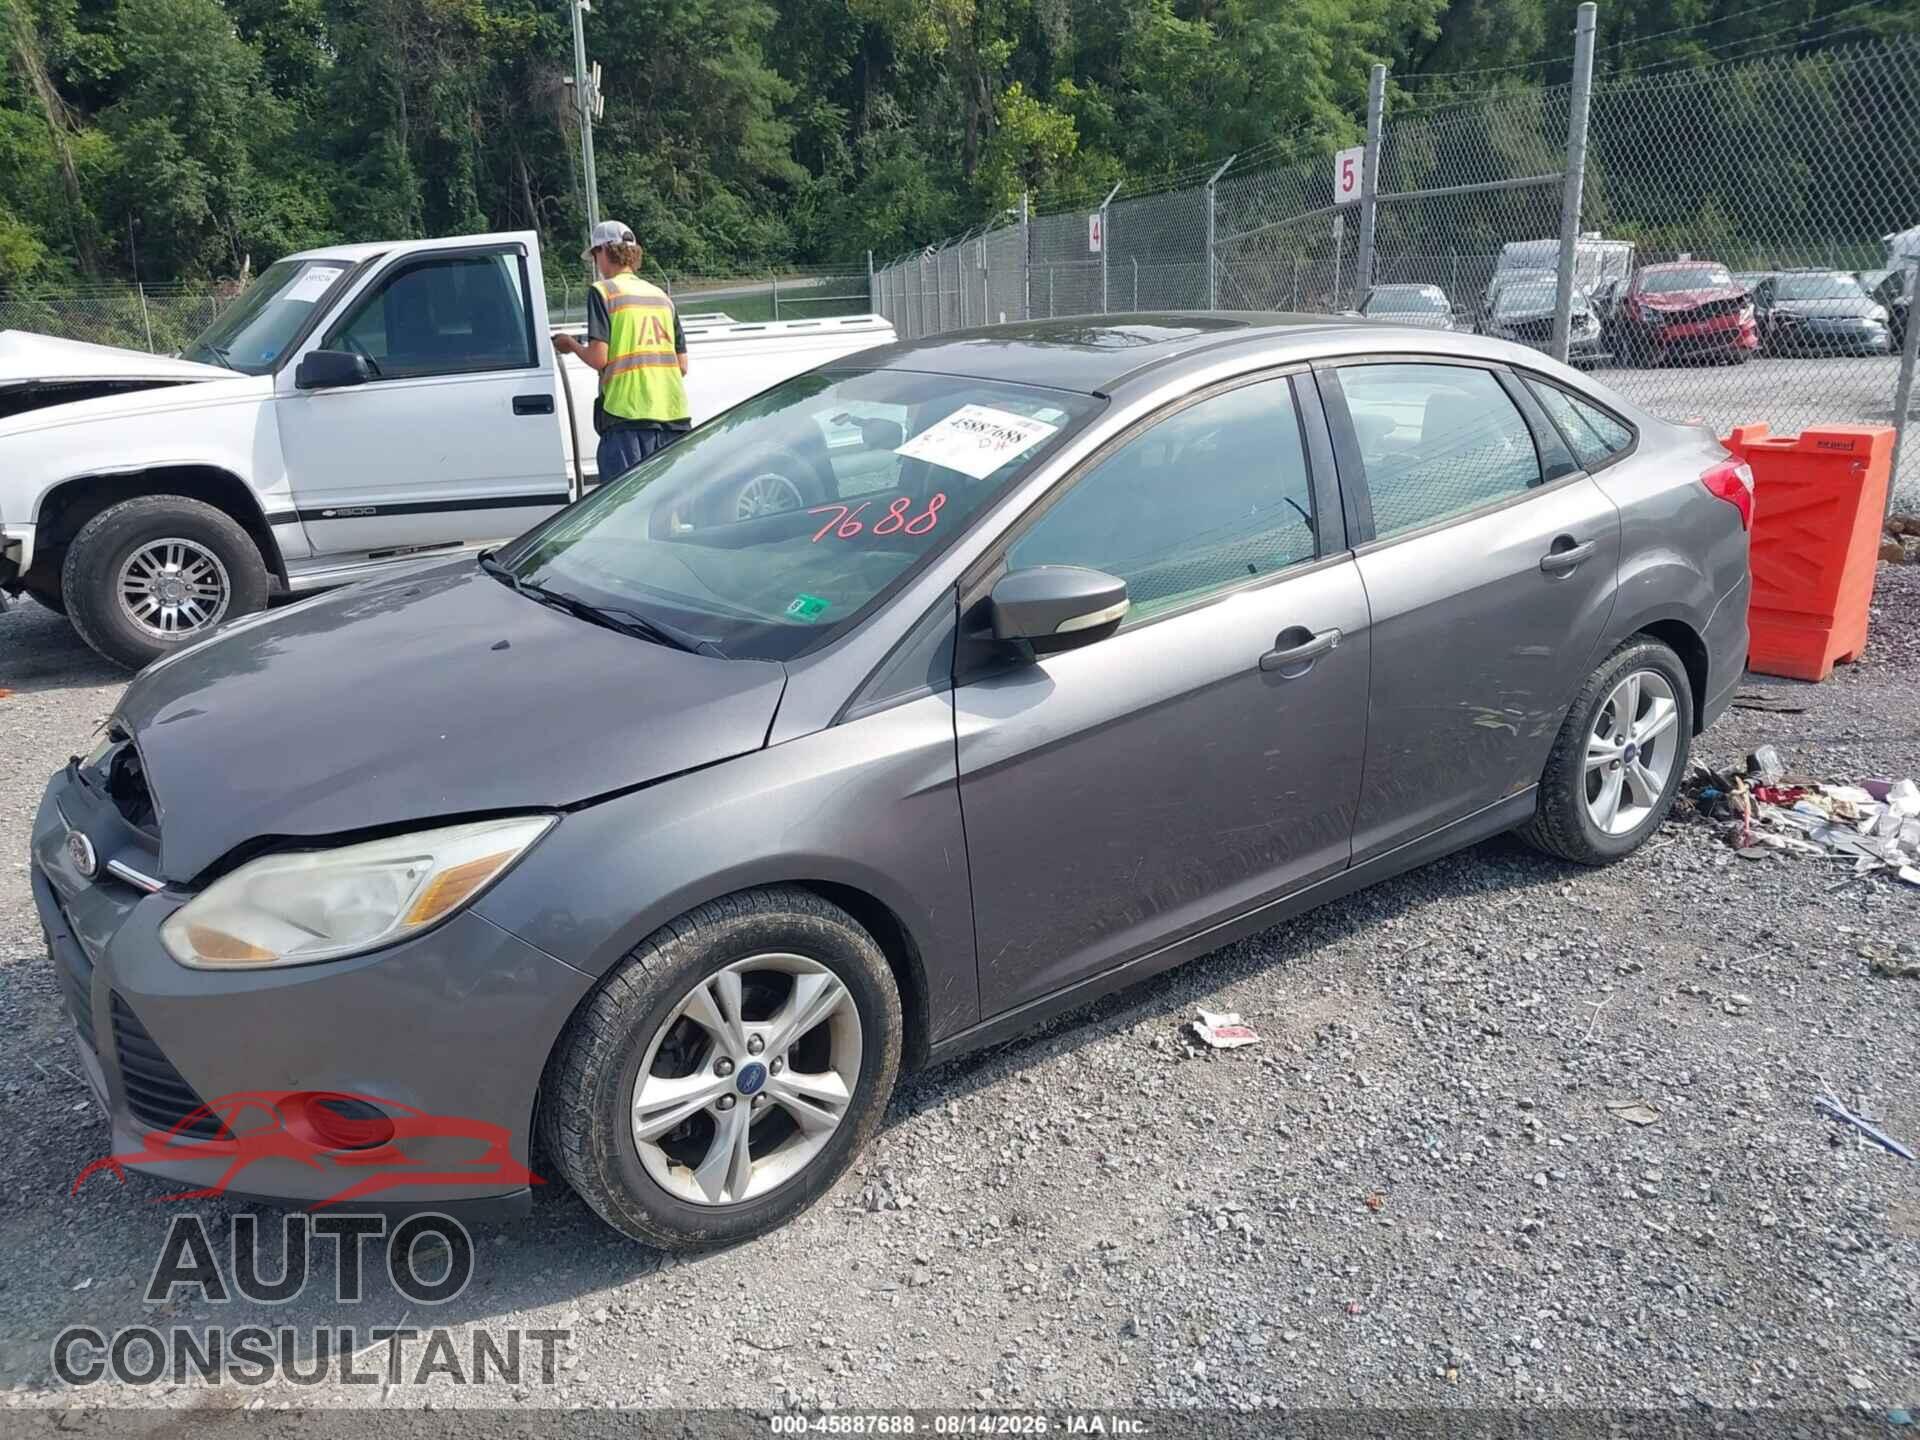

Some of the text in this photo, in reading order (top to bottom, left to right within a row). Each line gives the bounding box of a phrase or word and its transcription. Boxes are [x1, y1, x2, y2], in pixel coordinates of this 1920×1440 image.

[1342, 159, 1355, 192] 5
[638, 315, 673, 345] IAA
[808, 491, 946, 543] 7688
